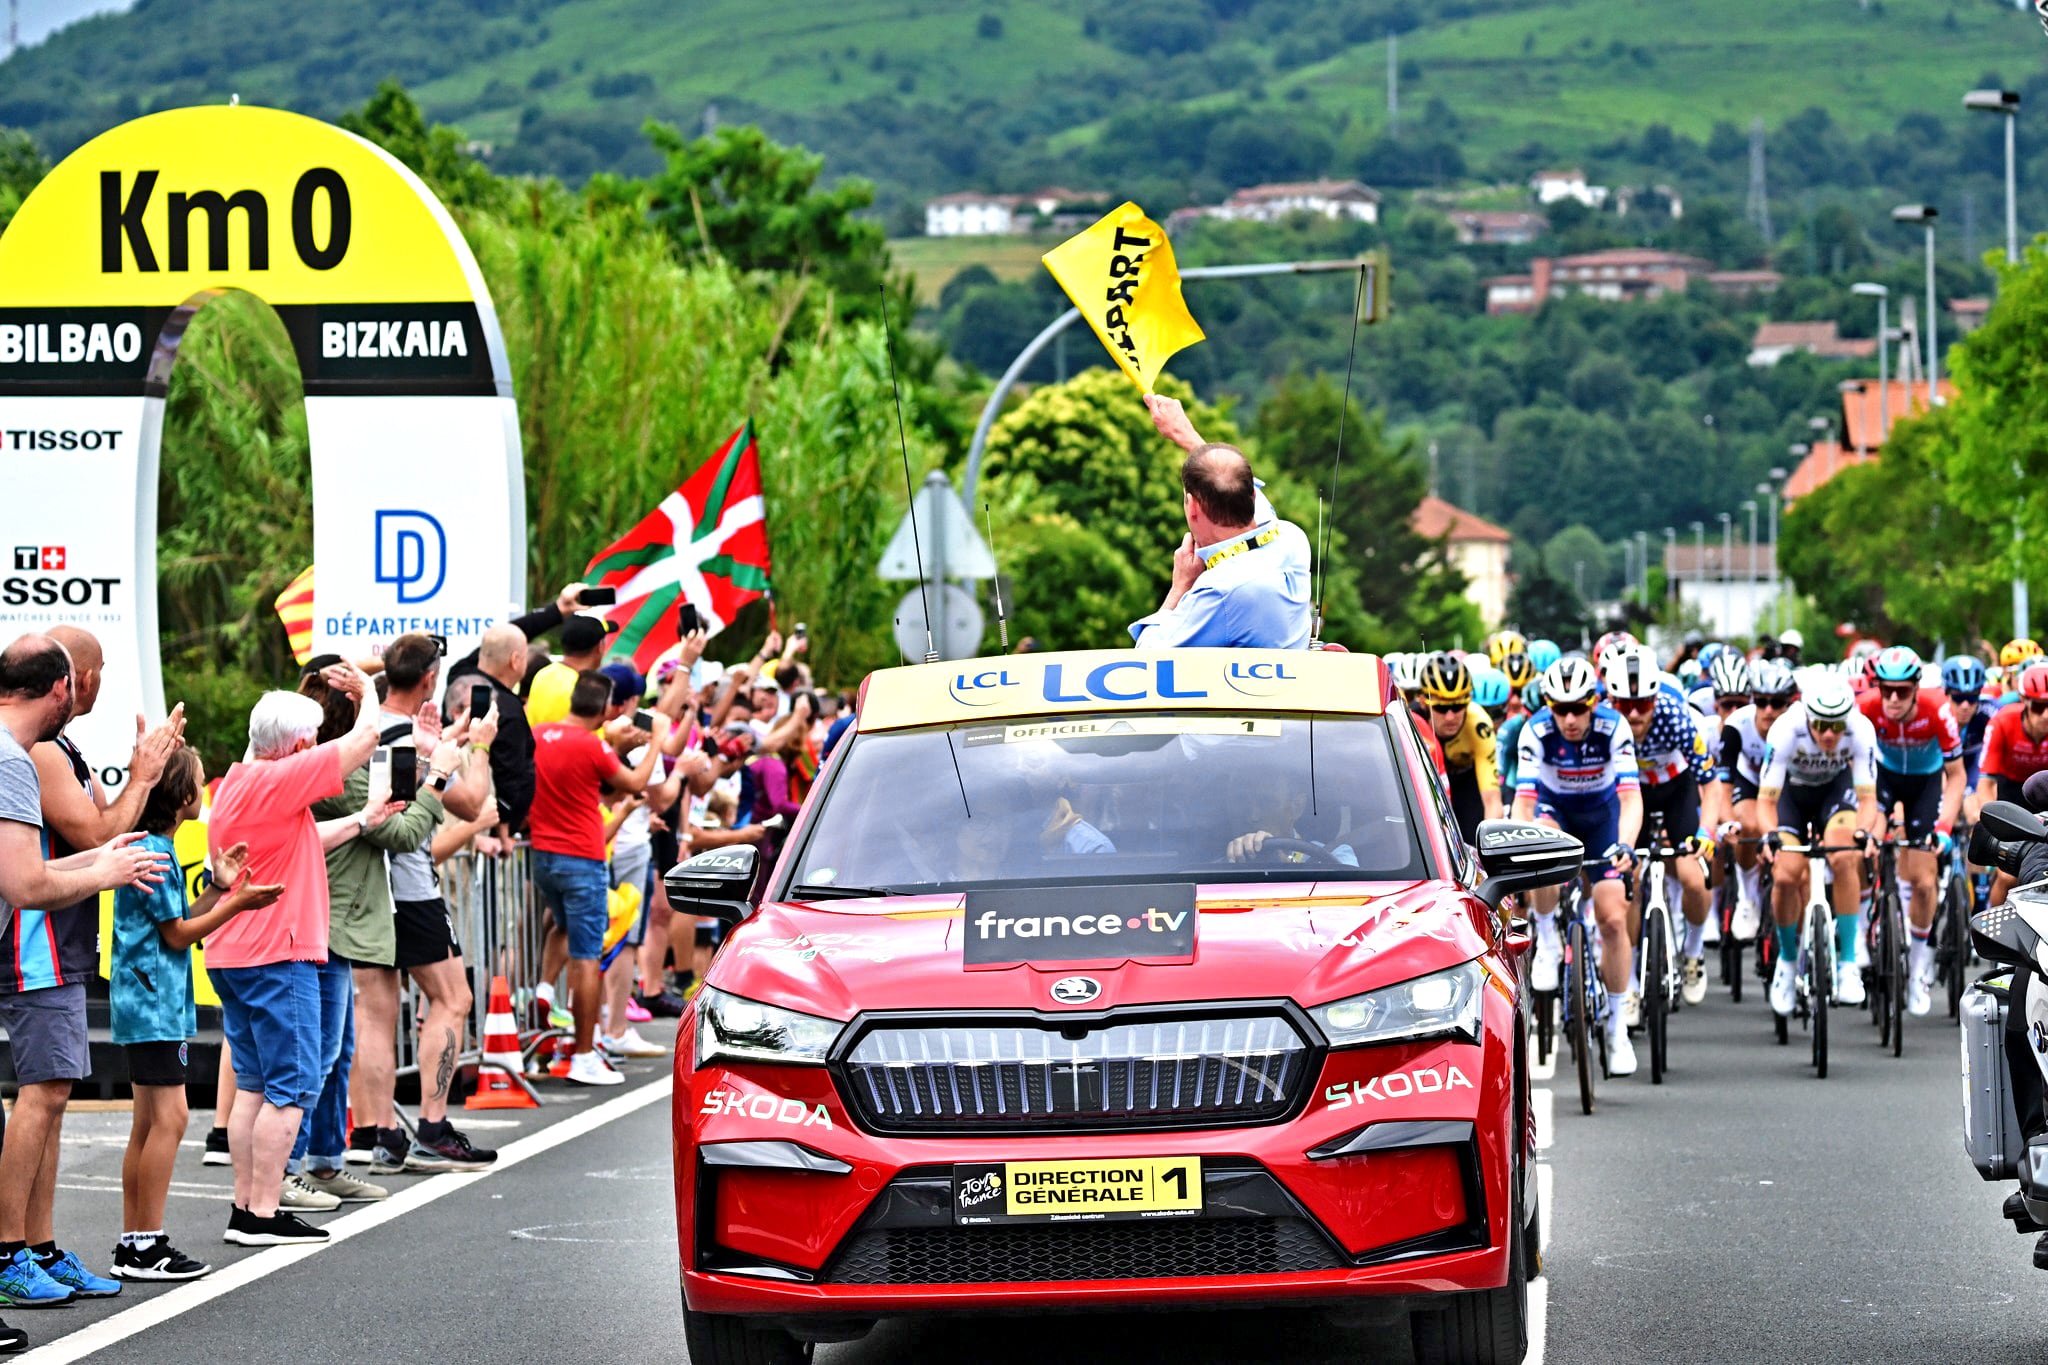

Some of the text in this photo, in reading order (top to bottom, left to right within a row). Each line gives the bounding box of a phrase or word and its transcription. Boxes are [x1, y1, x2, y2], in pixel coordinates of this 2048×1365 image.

[100, 167, 351, 272] Km 0
[0, 322, 142, 363] BILBAO
[322, 321, 467, 358] BIZKAIA
[6, 430, 123, 450] TISSOT
[956, 670, 1020, 690] LCL
[1230, 662, 1297, 680] LCL
[1042, 660, 1208, 703] LCL
[1013, 720, 1254, 738] OFFICIEL 1
[686, 855, 744, 870] KODA
[1014, 1169, 1144, 1186] DIRECTION
[1161, 1167, 1188, 1200] 1
[1015, 1186, 1144, 1204] GÉNÉRALE
